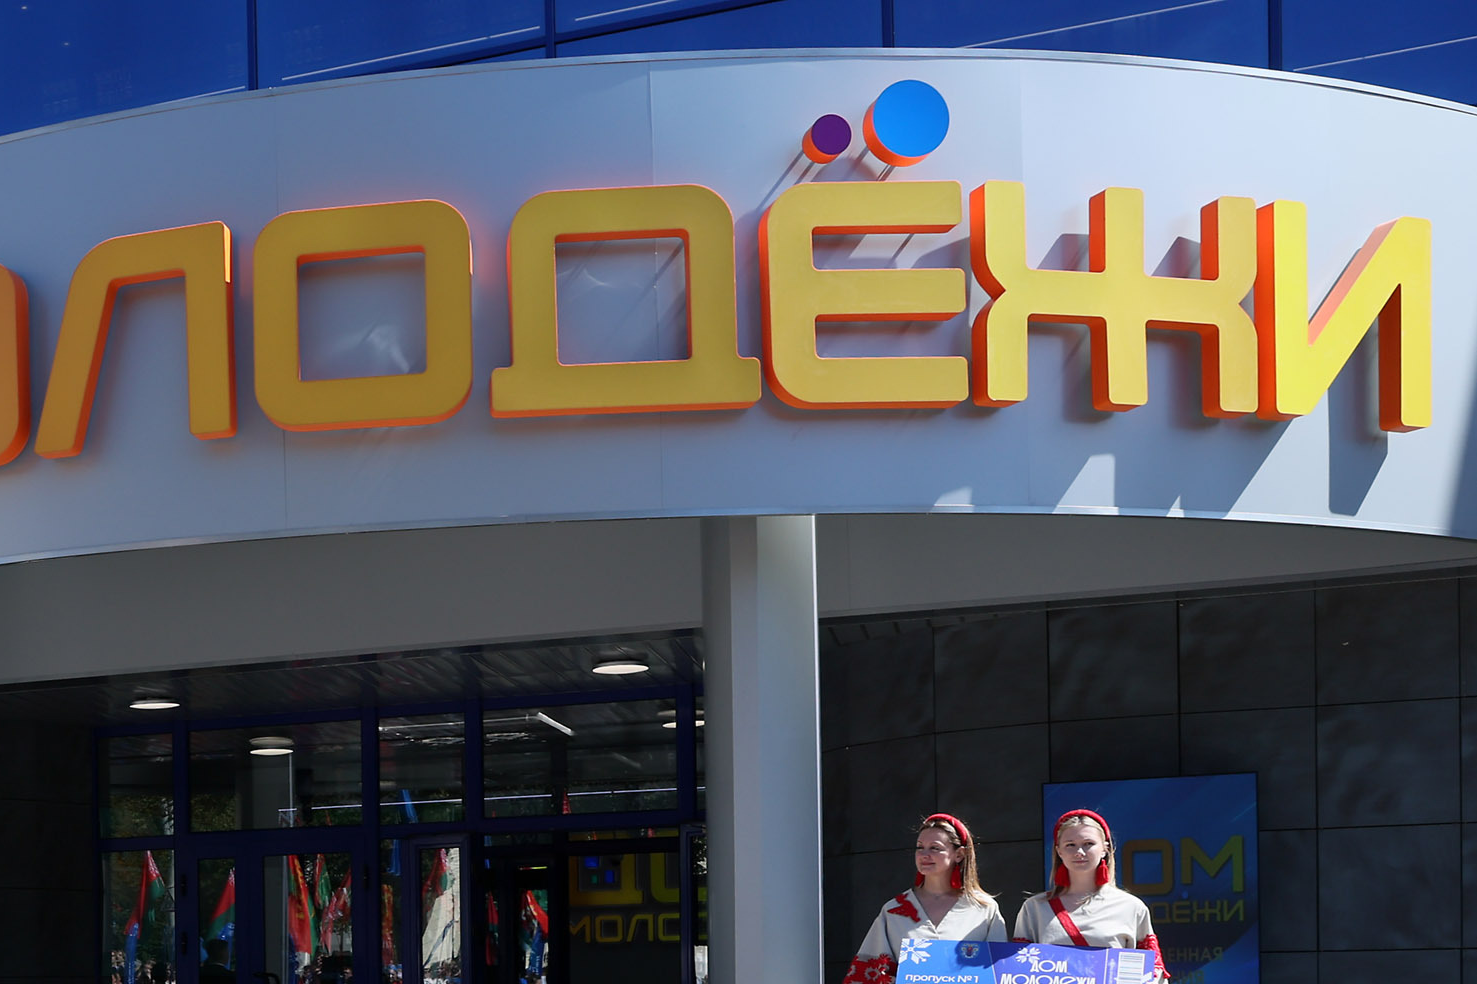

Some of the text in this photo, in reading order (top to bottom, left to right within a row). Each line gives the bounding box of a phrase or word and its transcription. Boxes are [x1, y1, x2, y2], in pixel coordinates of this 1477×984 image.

[1121, 835, 1244, 895] ОМ
[1151, 890, 1244, 924] ДЁЖИ
[1030, 960, 1068, 973] ДОМ
[905, 974, 955, 983] пропуск
